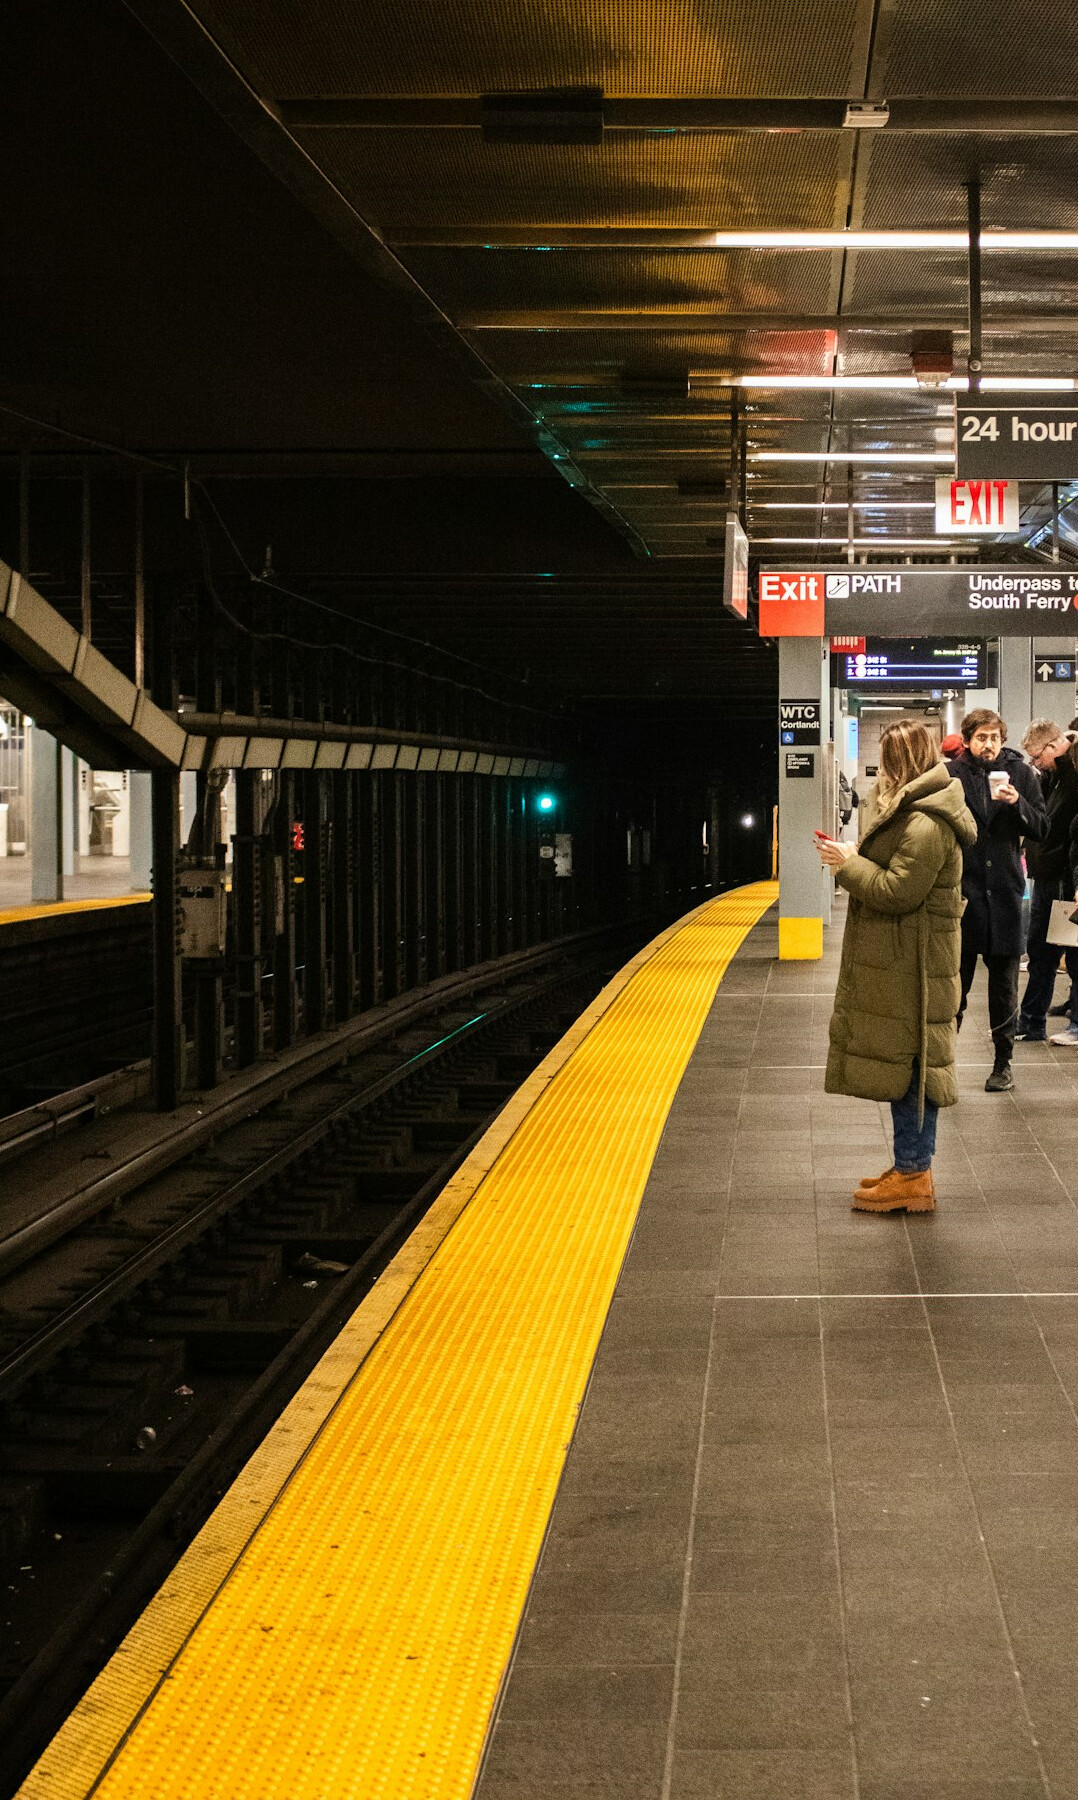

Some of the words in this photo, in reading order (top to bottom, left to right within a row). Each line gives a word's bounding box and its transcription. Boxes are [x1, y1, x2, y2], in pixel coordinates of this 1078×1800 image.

[961, 416, 1000, 441] 24
[1012, 416, 1078, 441] hour
[951, 481, 1007, 524] EXIT
[761, 576, 818, 601] Exit
[851, 575, 901, 593] PATH
[969, 575, 1062, 594] Underpass
[969, 593, 1020, 609] South
[1026, 593, 1072, 612] Ferry
[781, 706, 816, 719] WTC
[781, 721, 820, 729] Cortlandt
